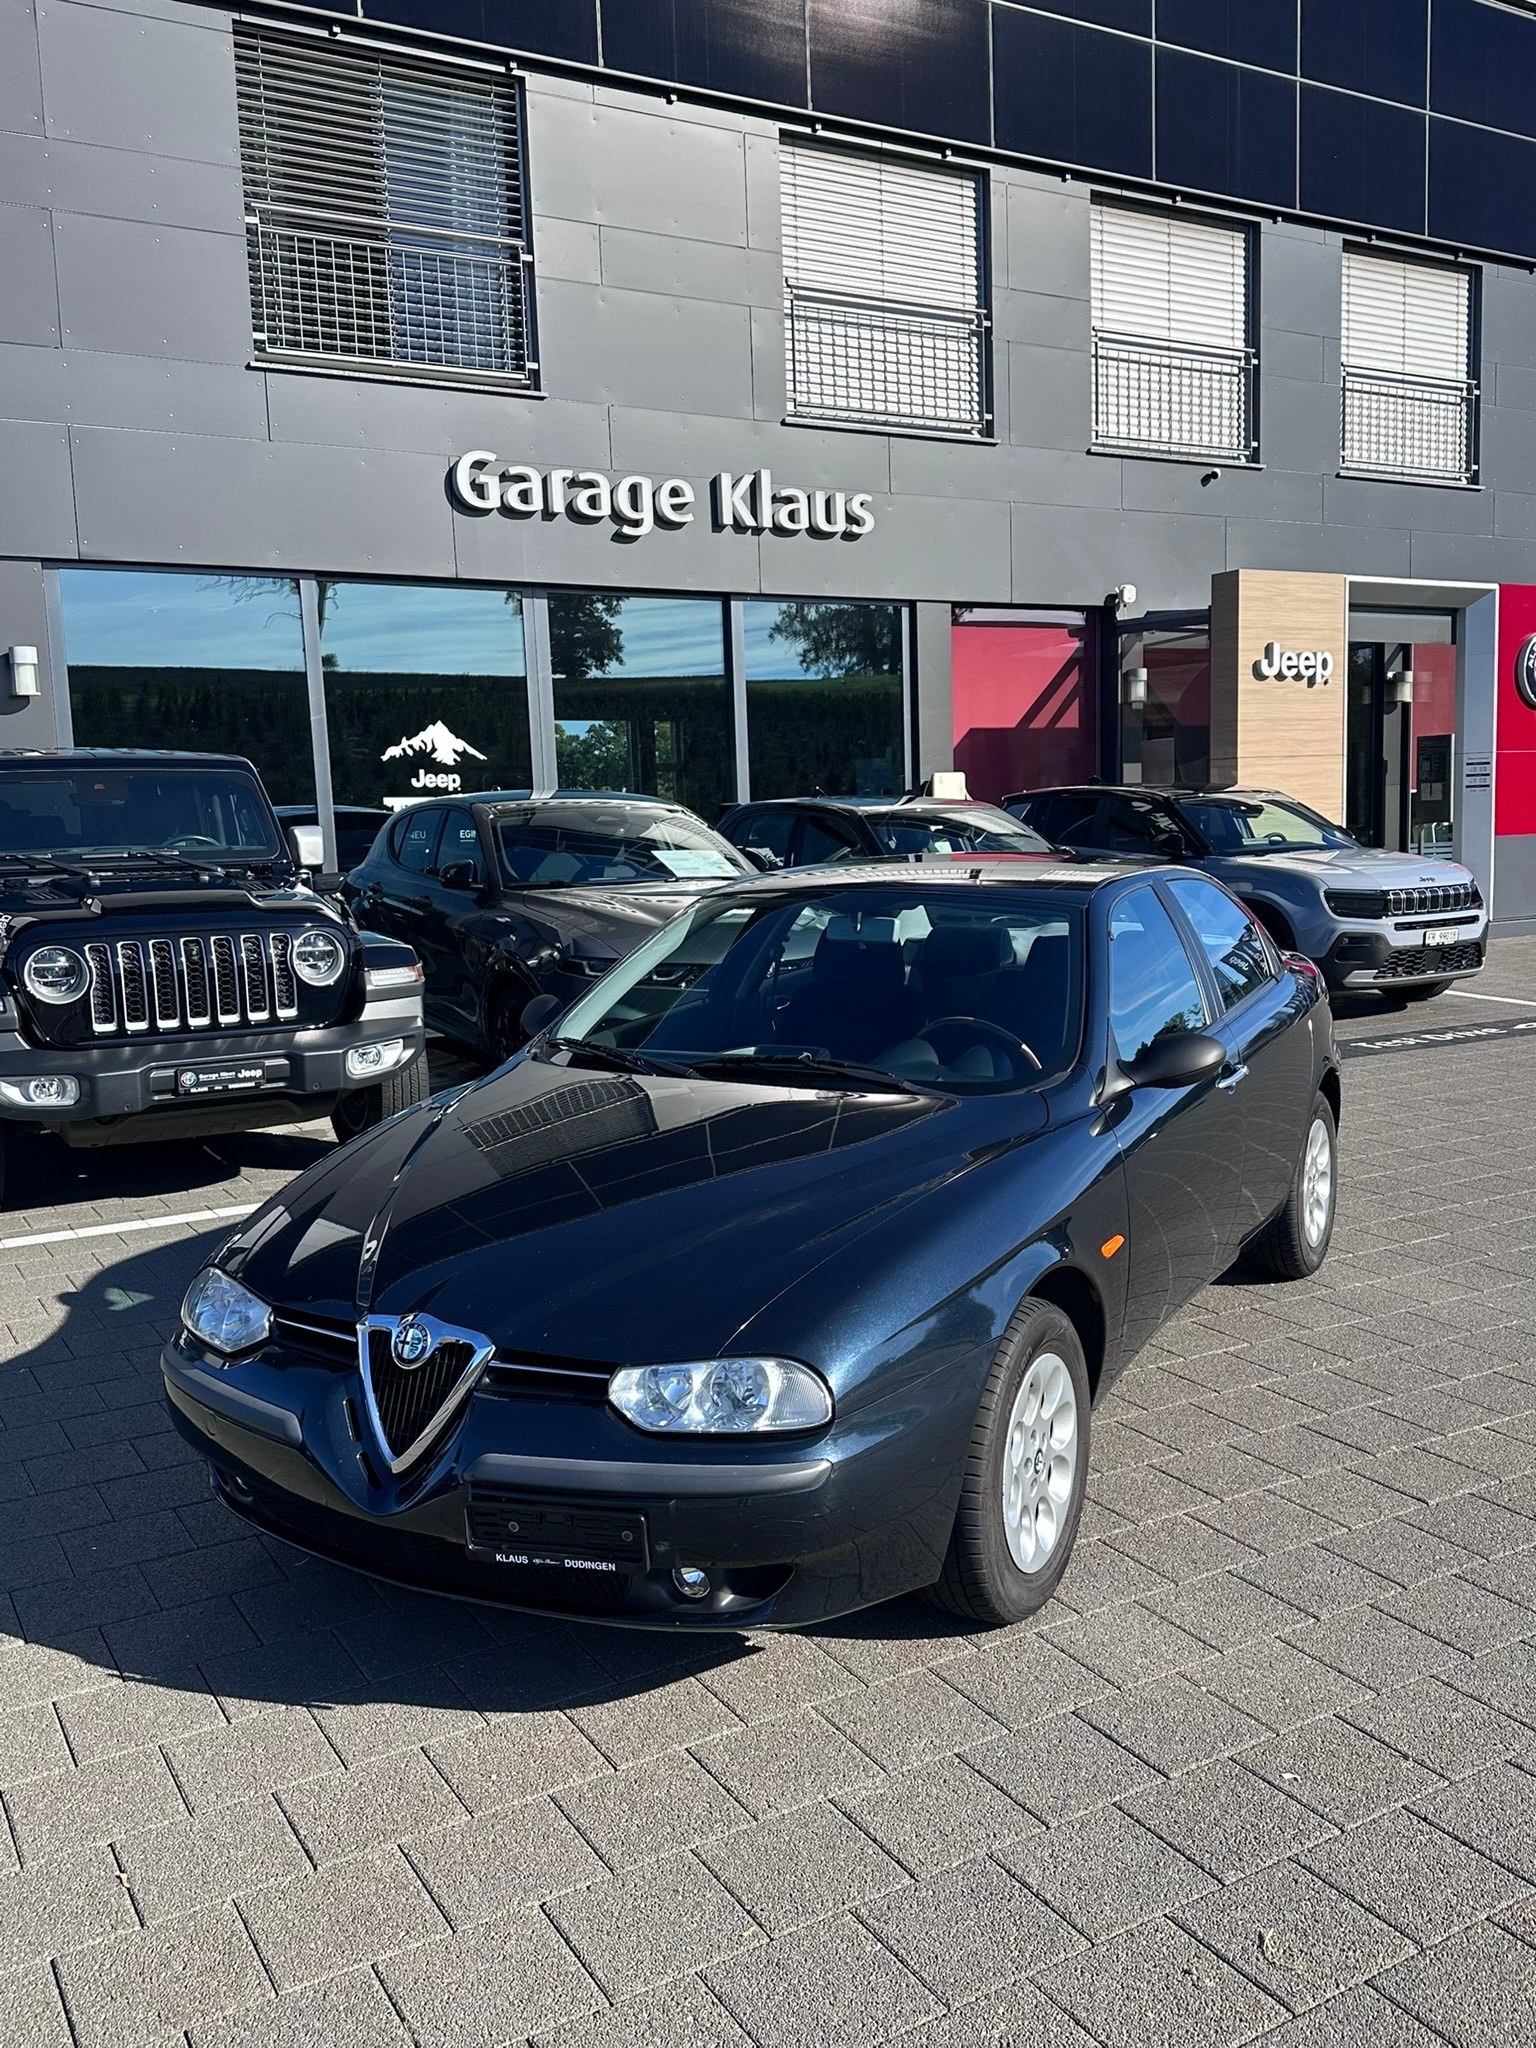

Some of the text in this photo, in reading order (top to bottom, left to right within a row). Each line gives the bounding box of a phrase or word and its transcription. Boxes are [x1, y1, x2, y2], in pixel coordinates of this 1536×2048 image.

[454, 449, 875, 537] Garage Klaus
[1256, 641, 1333, 685] Jeep
[410, 769, 461, 791] Jeep
[1350, 1027, 1509, 1049] Test Drive
[237, 1069, 263, 1079] Jeep
[413, 1323, 428, 1347] ROMEO
[495, 1553, 529, 1564] KLAUS
